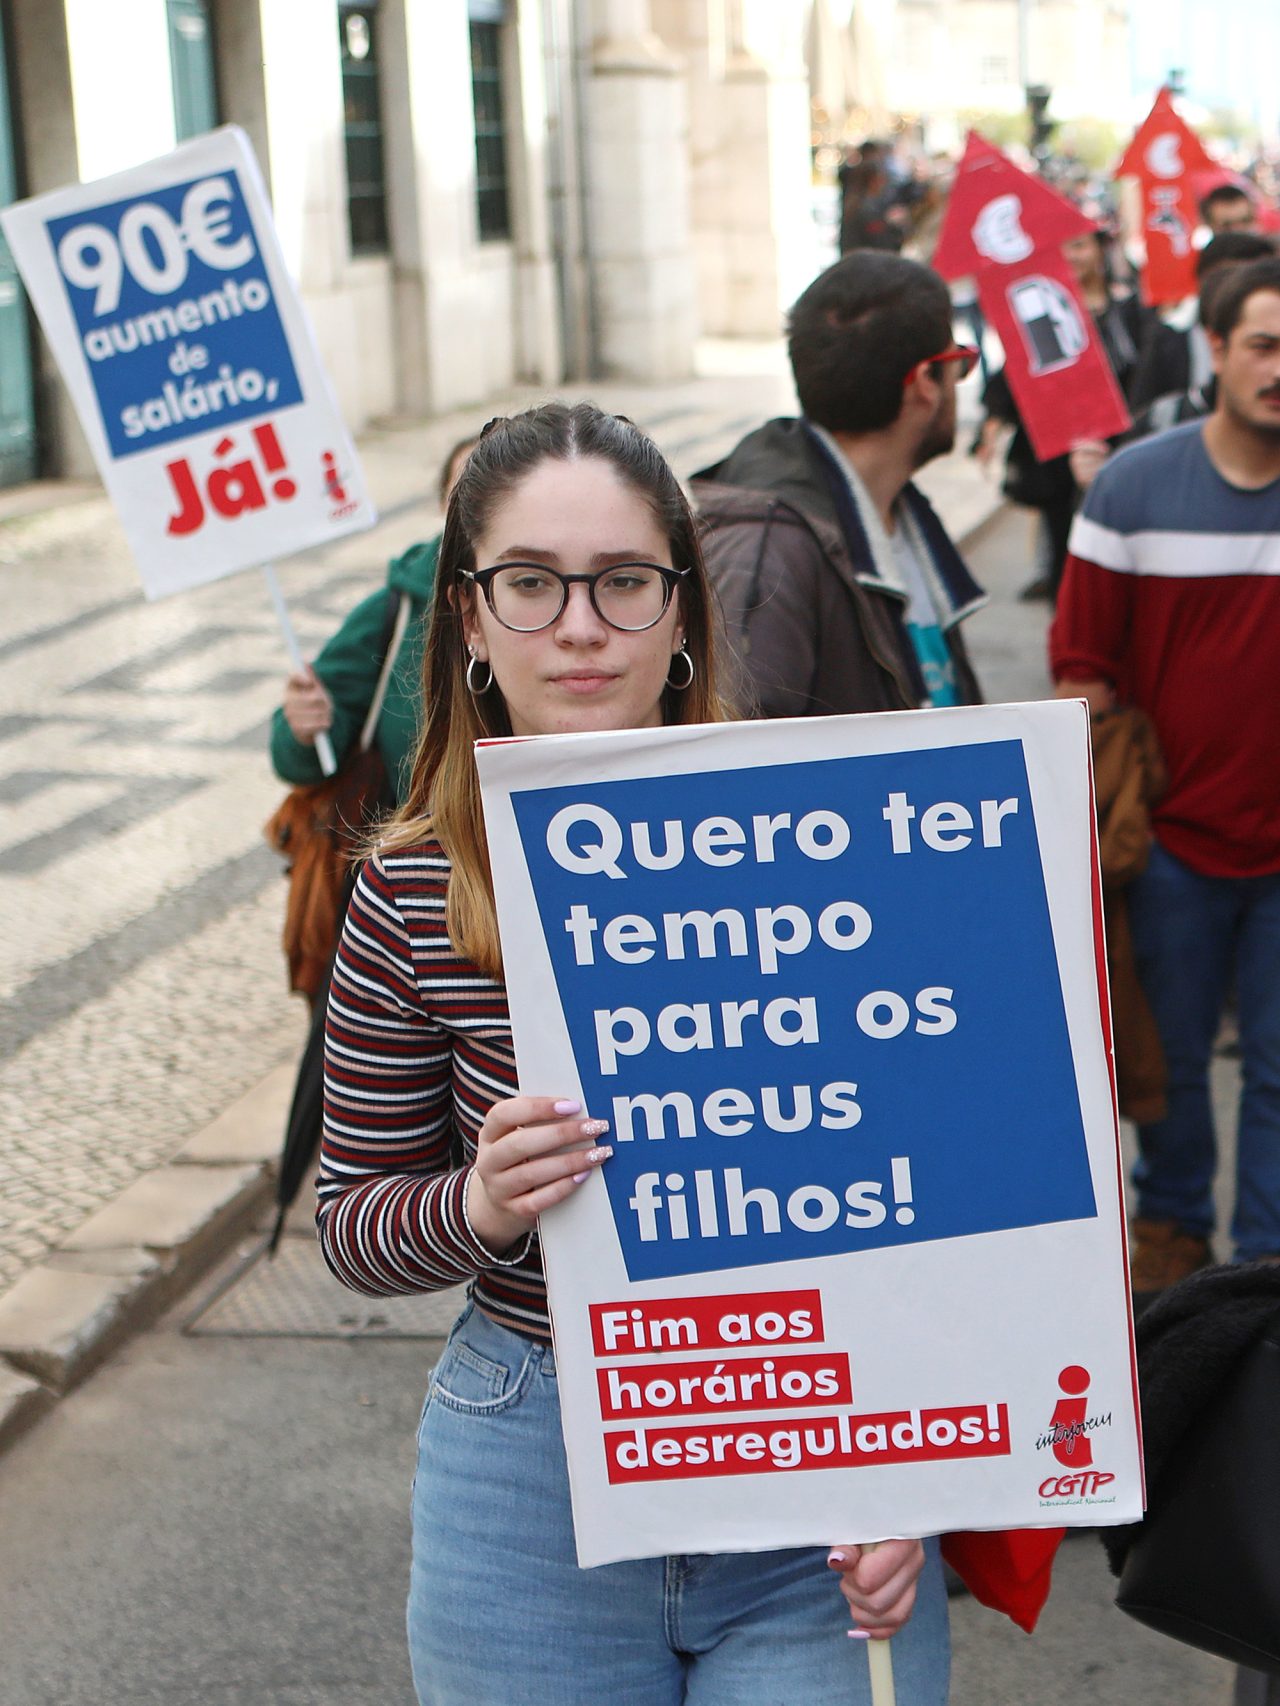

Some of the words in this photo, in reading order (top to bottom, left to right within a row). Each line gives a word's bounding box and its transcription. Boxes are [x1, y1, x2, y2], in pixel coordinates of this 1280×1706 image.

[58, 175, 254, 316] 90€
[83, 279, 270, 362] aumento
[168, 342, 209, 376] de
[121, 364, 280, 438] salário,
[166, 422, 297, 538] Já!
[546, 802, 851, 880] Quero
[882, 791, 1019, 854] ter
[564, 900, 873, 975] tempo
[594, 996, 821, 1076] para
[856, 986, 958, 1040] os
[612, 1081, 864, 1143] meus
[629, 1157, 916, 1243] filhos!
[601, 1308, 699, 1351] Fim
[718, 1308, 814, 1343] aos
[607, 1360, 840, 1411] horários
[615, 1403, 1002, 1468] desregulados!
[1038, 1470, 1116, 1498] CGTP
